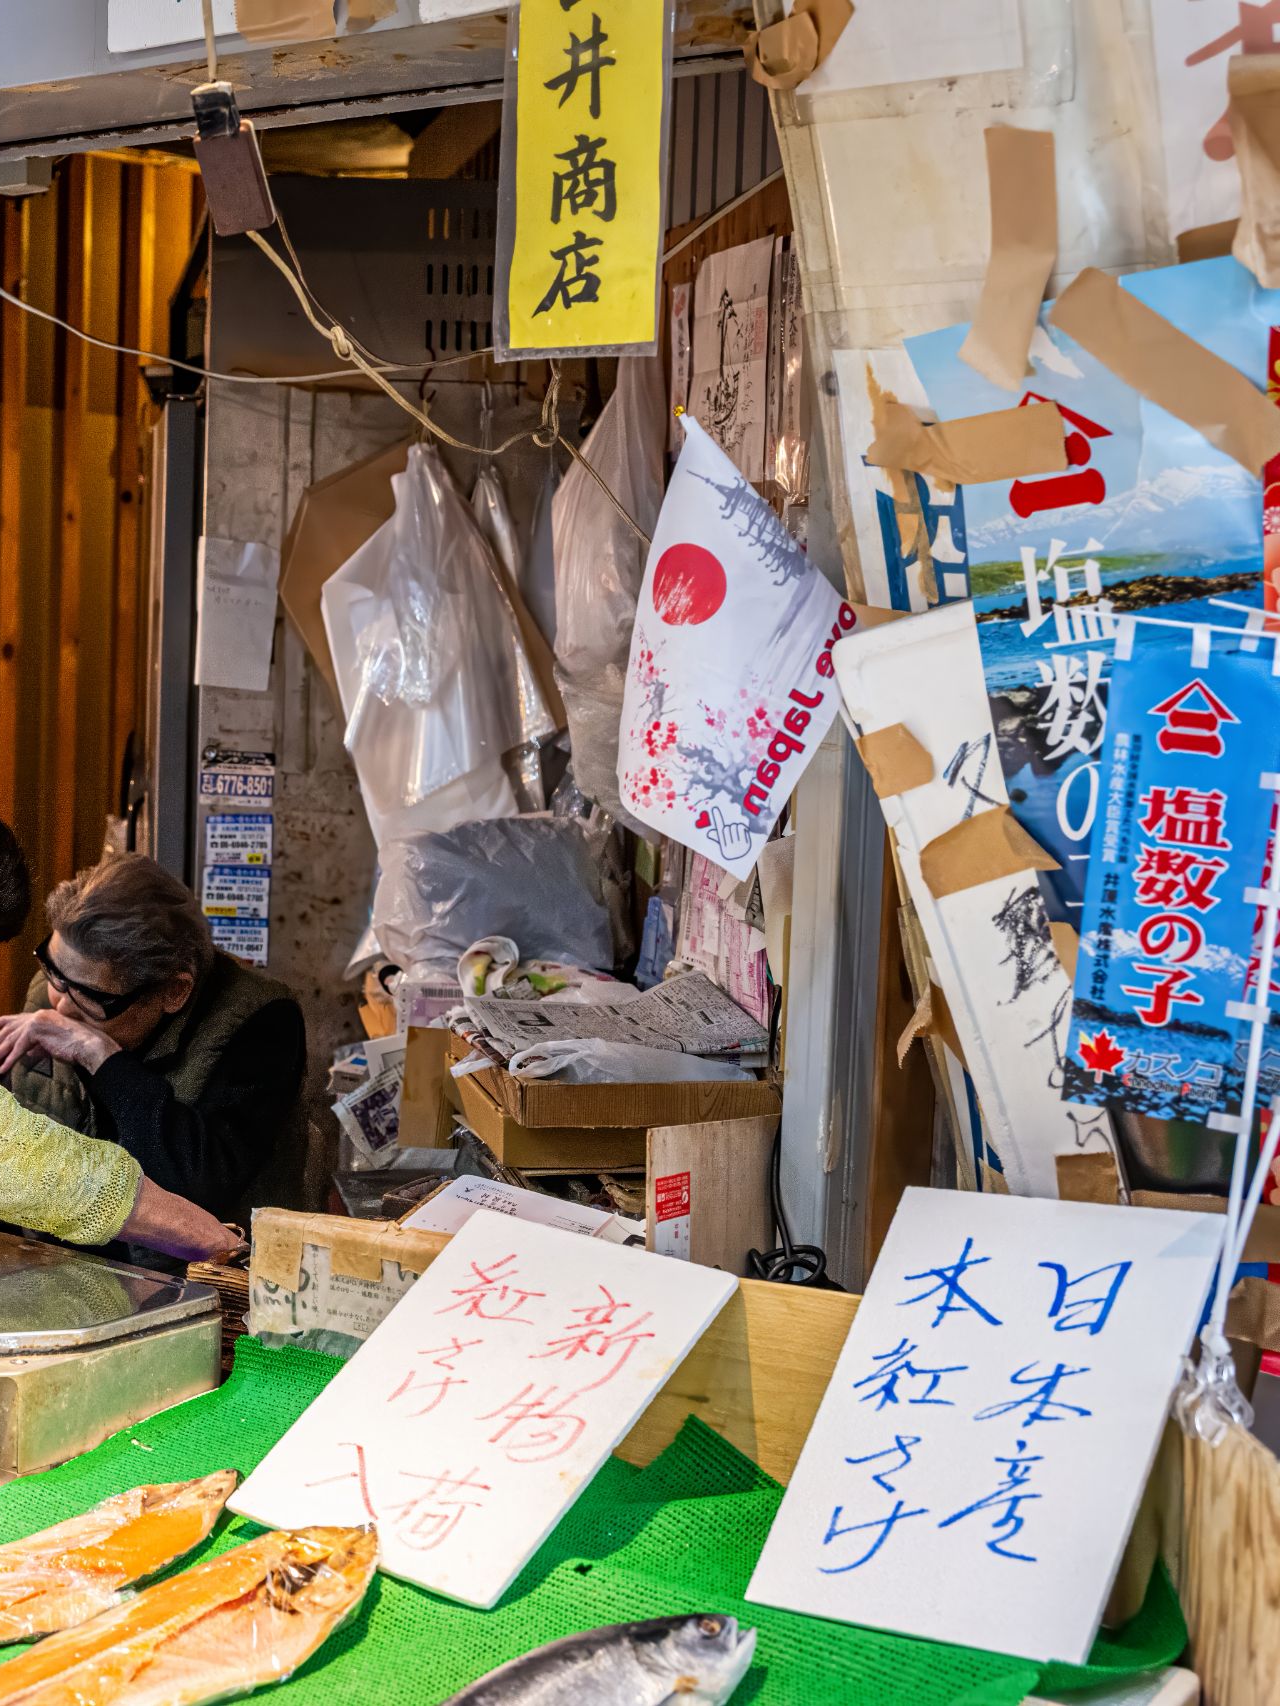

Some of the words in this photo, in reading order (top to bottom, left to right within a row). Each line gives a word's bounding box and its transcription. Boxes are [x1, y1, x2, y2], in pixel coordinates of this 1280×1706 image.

[532, 0, 618, 318] 井商店
[216, 774, 273, 796] 6776-8501
[1121, 785, 1232, 1028] 塩数の子
[1124, 1049, 1224, 1087] カズノコ
[387, 1253, 547, 1418] 紅さけ
[475, 1284, 656, 1464] 新物
[817, 1236, 1004, 1575] 本紅さけ
